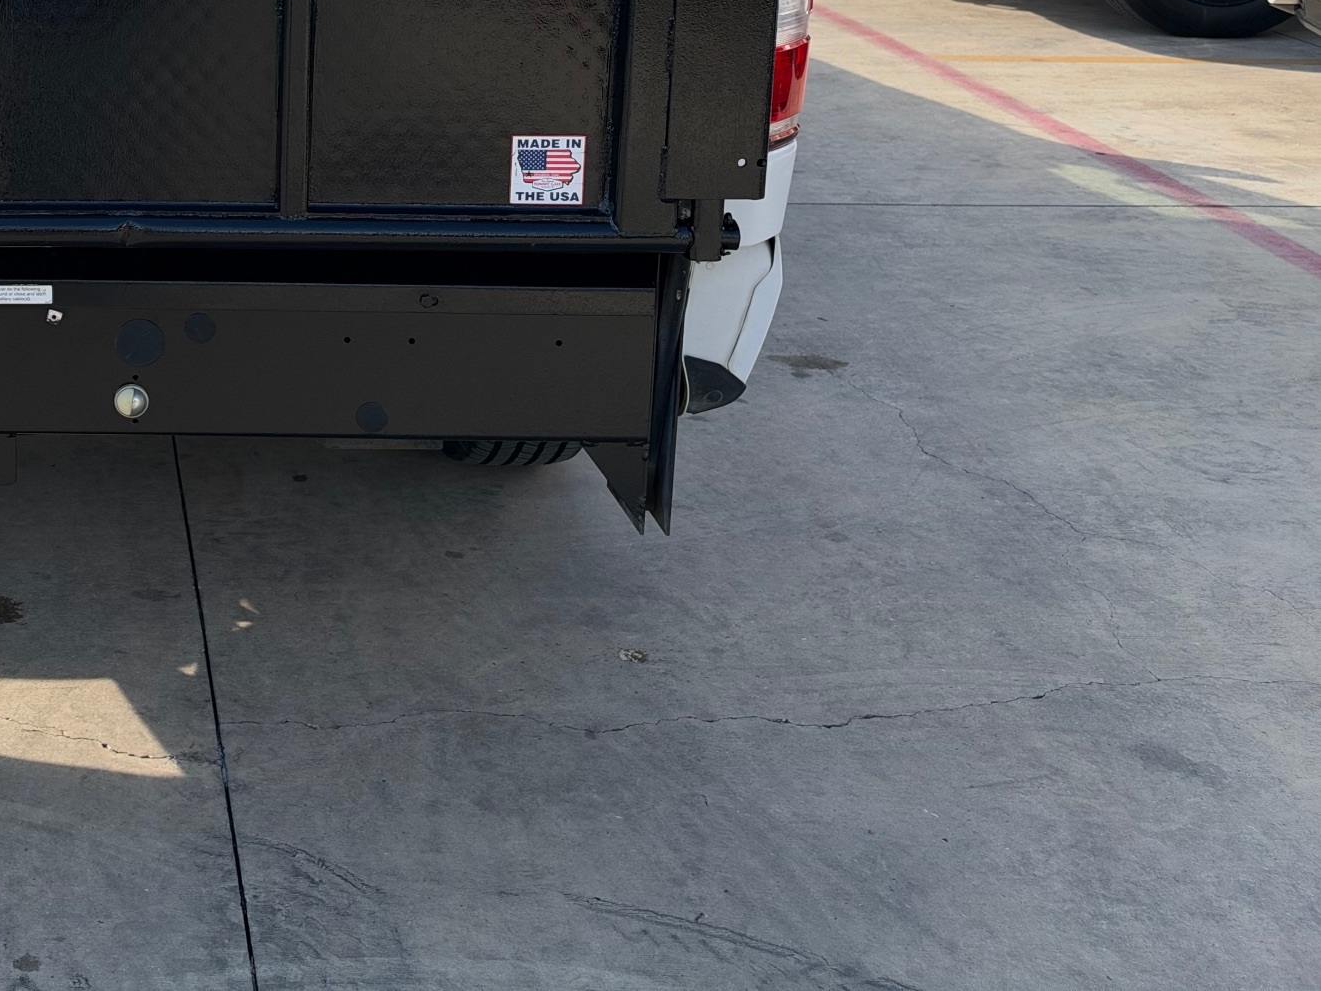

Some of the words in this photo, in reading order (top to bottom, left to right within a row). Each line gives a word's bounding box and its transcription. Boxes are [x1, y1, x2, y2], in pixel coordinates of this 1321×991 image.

[517, 139, 560, 148] MADE
[566, 139, 582, 149] IN
[515, 191, 545, 201] THE
[549, 191, 580, 202] USA
